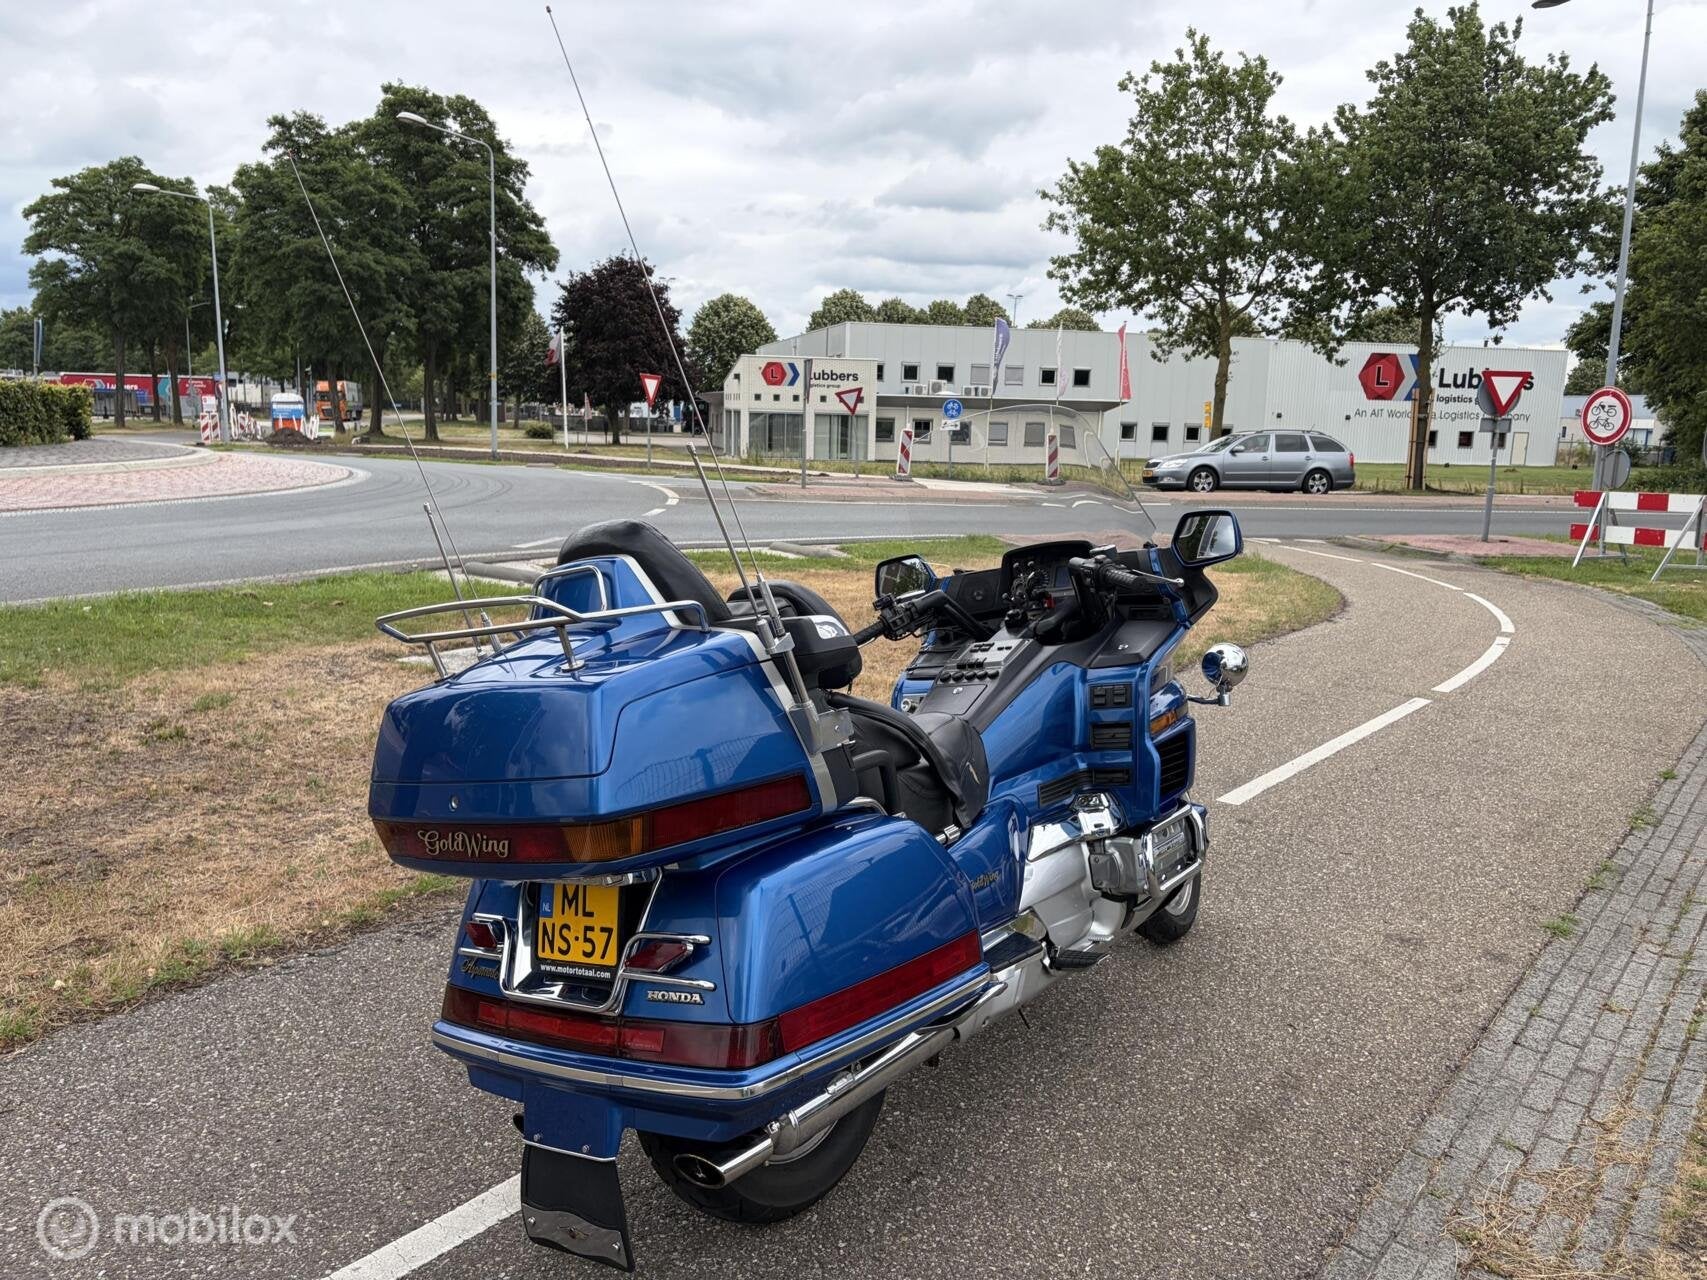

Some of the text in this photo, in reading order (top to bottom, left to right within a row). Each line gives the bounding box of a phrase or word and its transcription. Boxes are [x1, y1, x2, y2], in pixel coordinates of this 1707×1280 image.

[770, 368, 778, 379] L
[1375, 366, 1388, 386] L
[1436, 394, 1473, 404] logistics
[1354, 408, 1367, 418] An
[1370, 408, 1384, 418] AIT
[1439, 410, 1480, 422] Logistics
[417, 829, 509, 858] GoldWing
[542, 902, 551, 912] NL
[561, 884, 595, 918] ML
[540, 964, 611, 979] www.motortotaal.com
[647, 990, 703, 1004] HONDA
